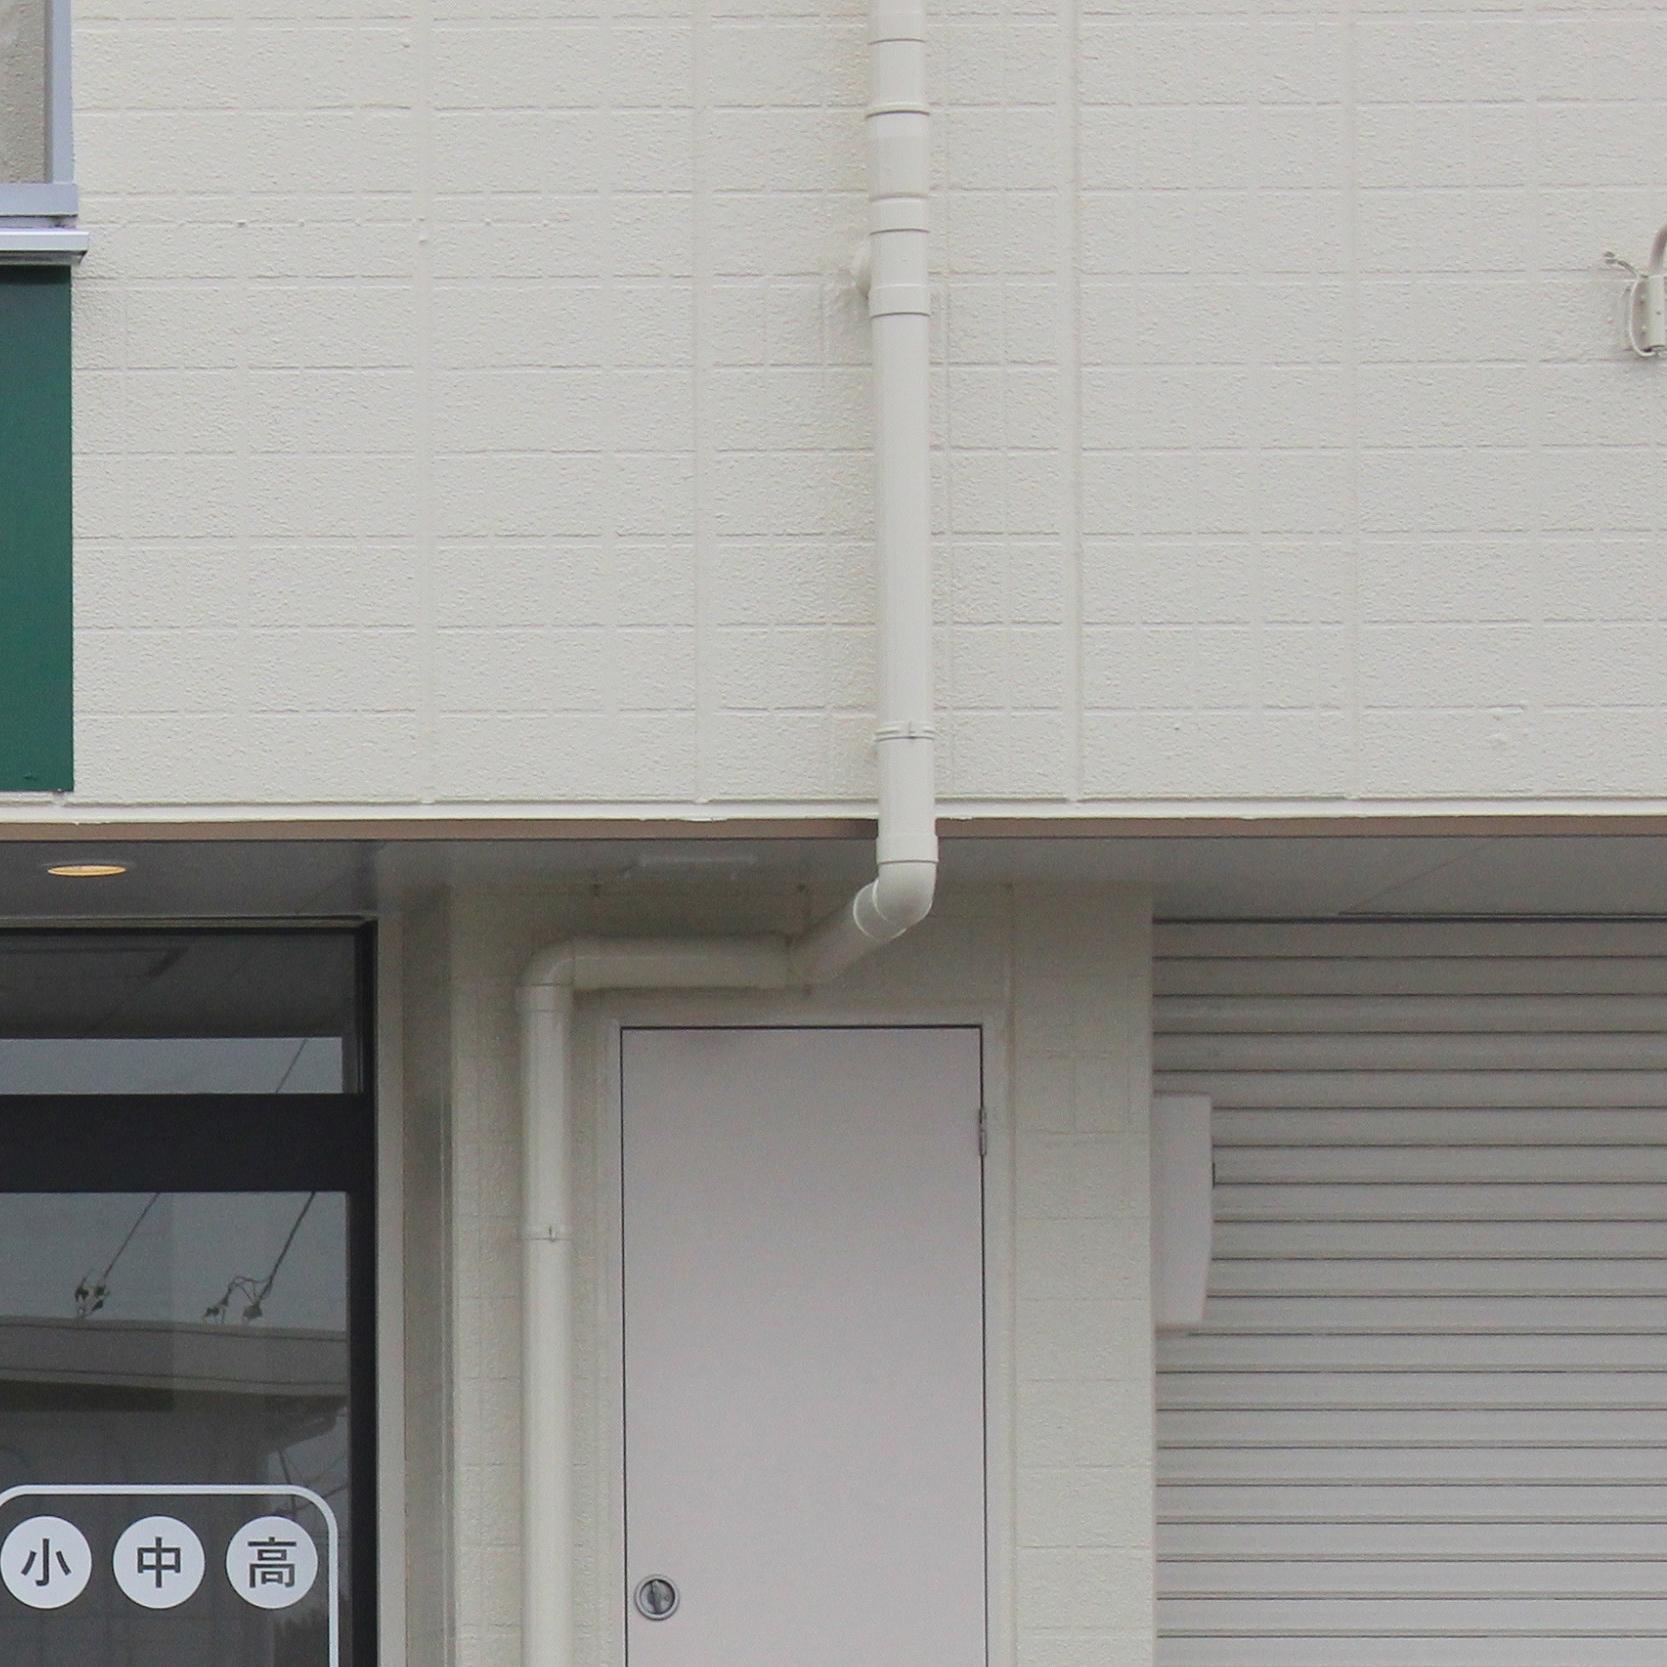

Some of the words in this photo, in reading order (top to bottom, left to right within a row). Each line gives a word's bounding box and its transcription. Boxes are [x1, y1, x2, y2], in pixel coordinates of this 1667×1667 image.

[21, 1538, 72, 1588] 小
[137, 1536, 182, 1588] 中
[247, 1536, 297, 1588] 高
